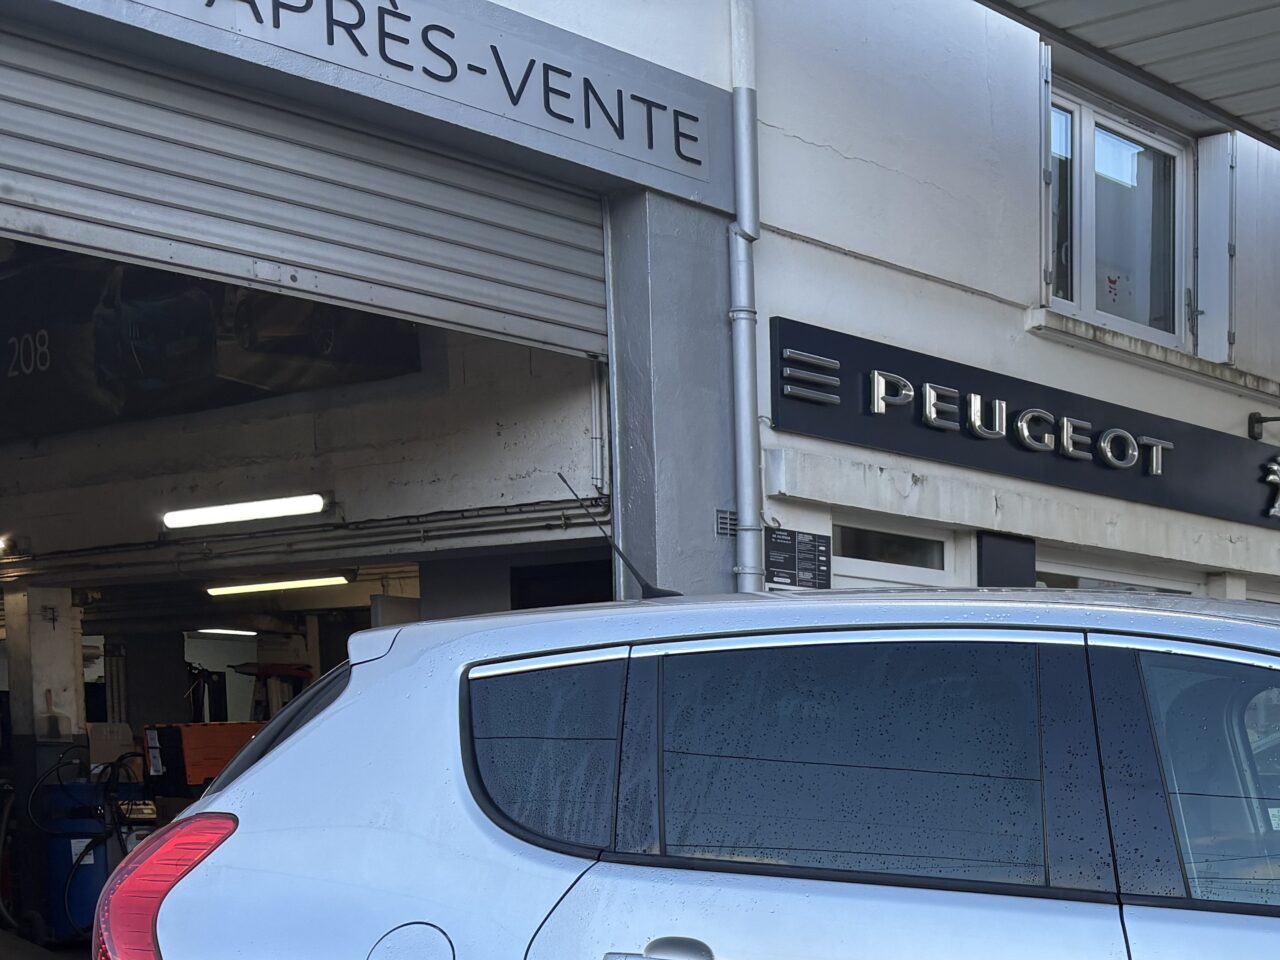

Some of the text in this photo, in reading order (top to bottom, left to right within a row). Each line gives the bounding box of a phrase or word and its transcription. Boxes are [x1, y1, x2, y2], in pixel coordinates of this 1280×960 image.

[205, 0, 703, 166] PRÈS-VENTE
[7, 328, 51, 378] 208
[870, 369, 1174, 476] PEUGEOT
